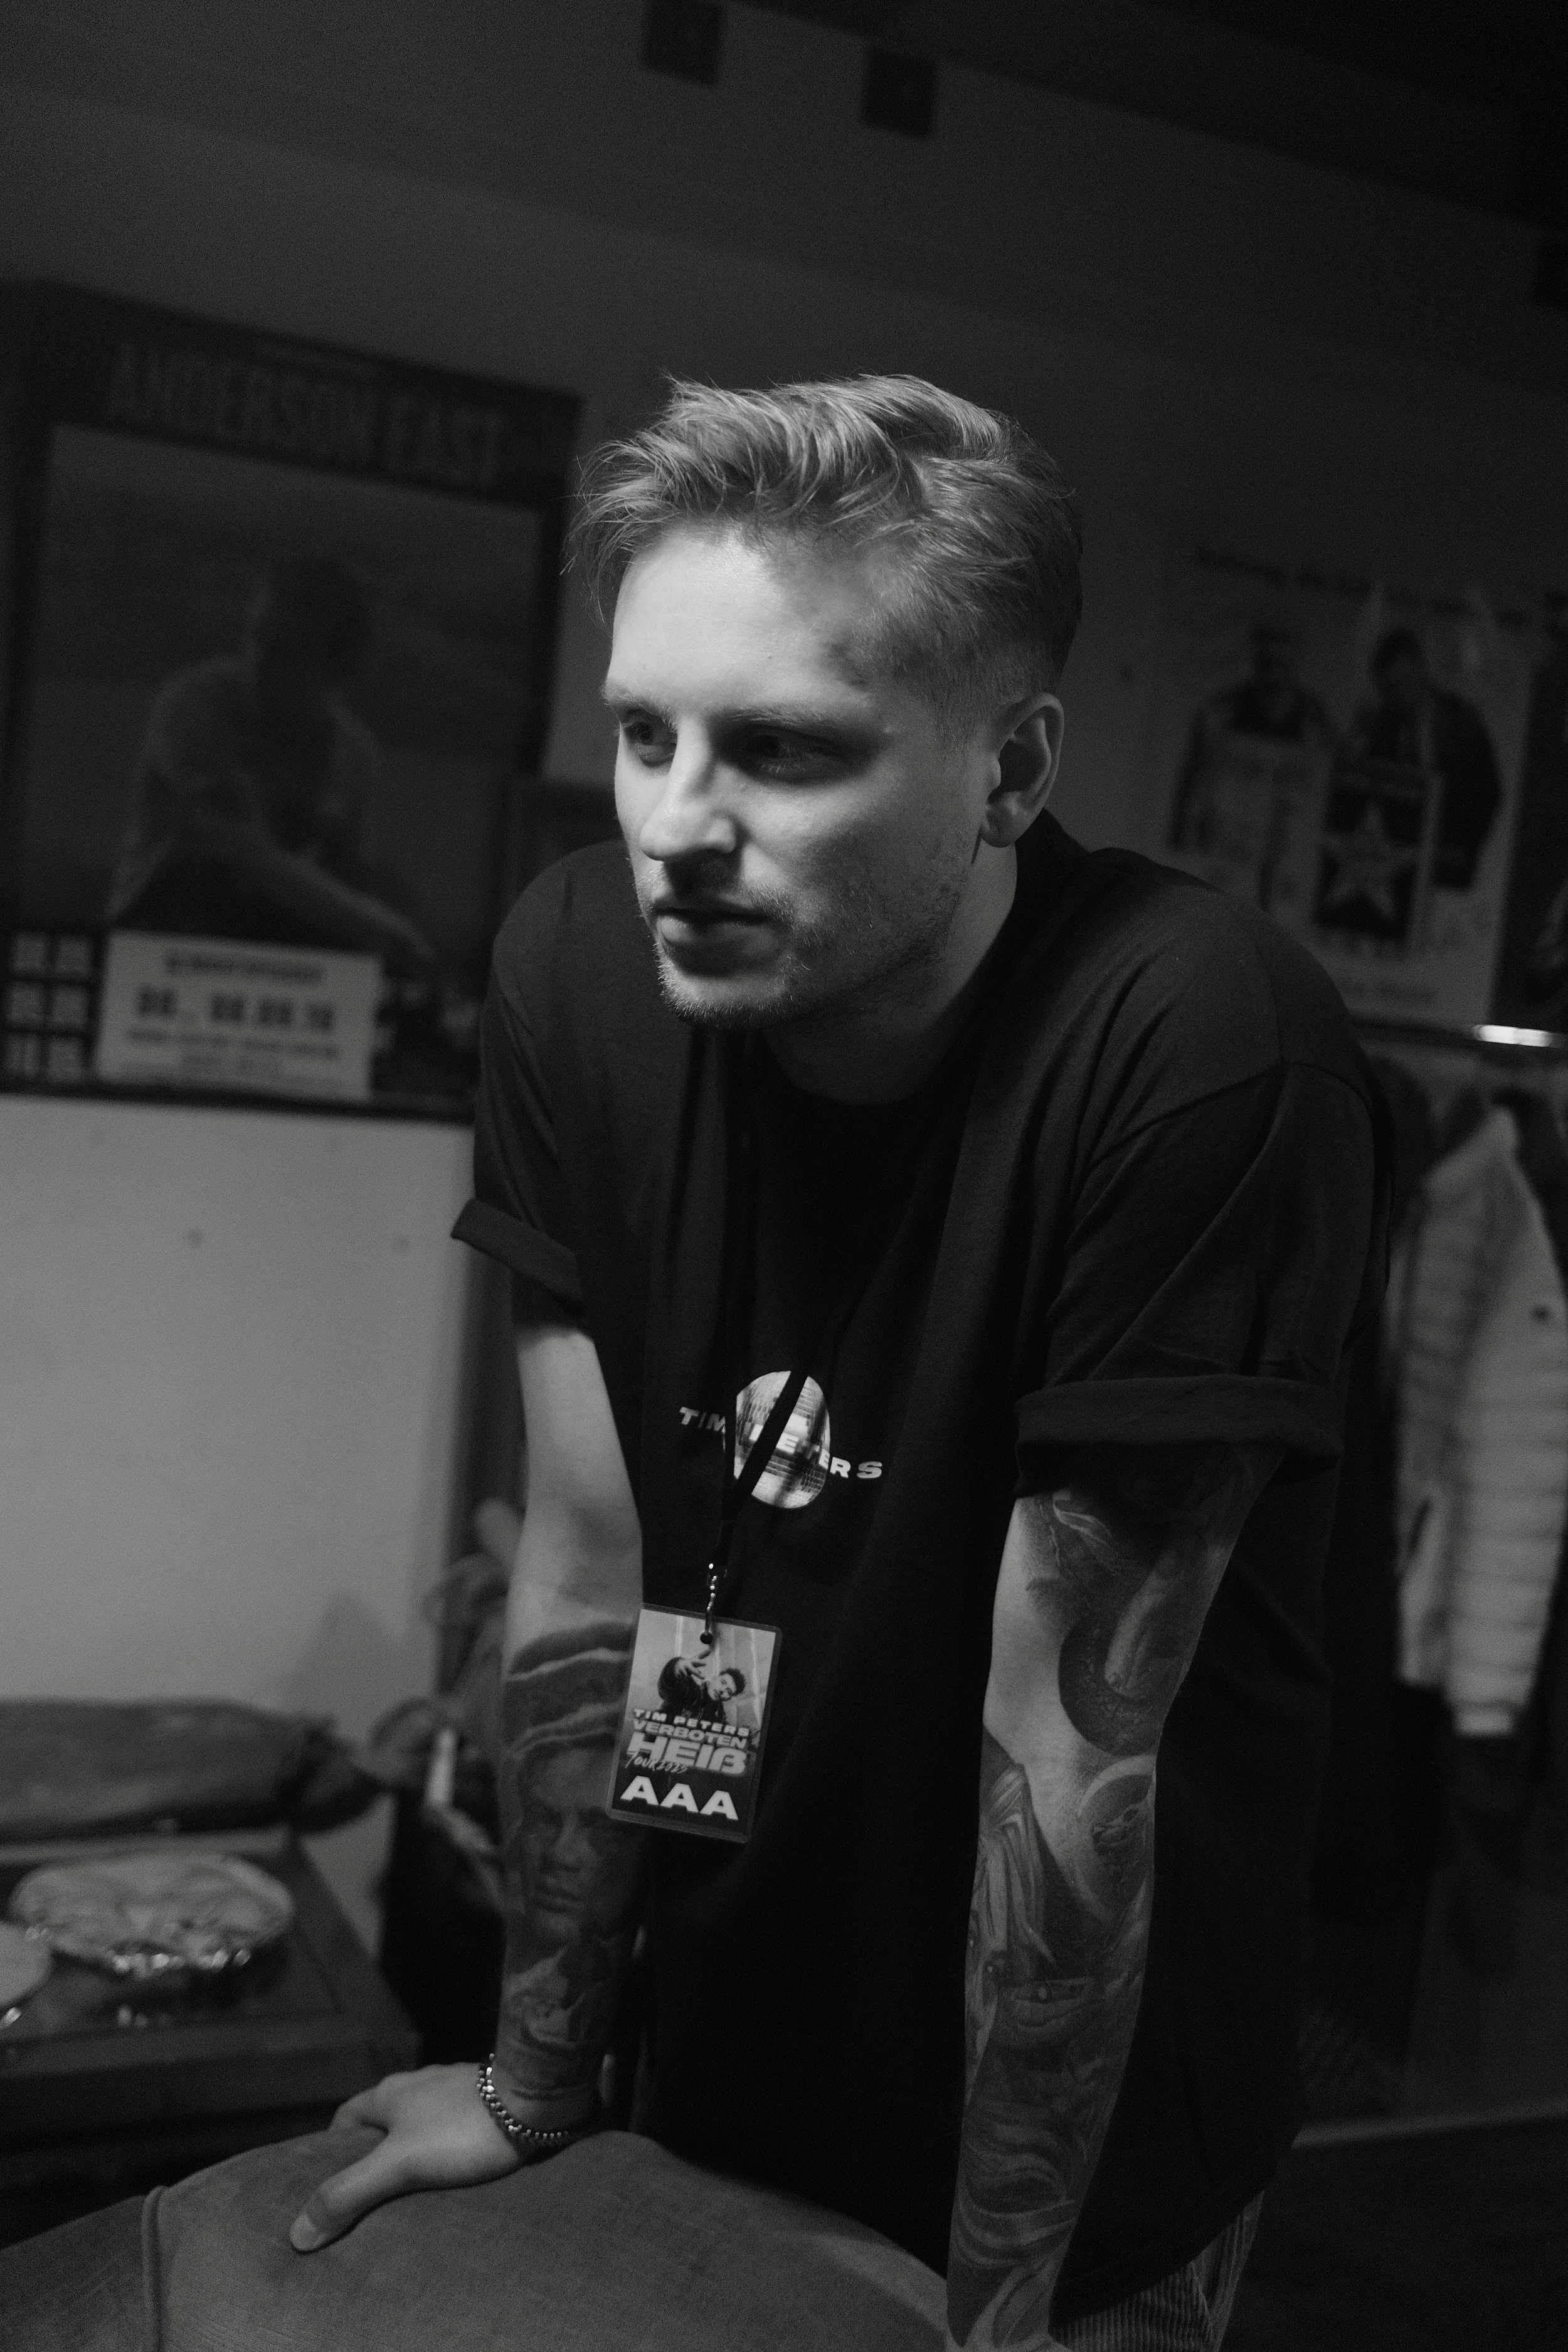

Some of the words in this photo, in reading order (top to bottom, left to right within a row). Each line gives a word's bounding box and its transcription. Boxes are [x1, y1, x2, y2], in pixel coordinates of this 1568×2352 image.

[108, 341, 378, 465] ANDERSON
[385, 395, 506, 488] EAST
[679, 1406, 726, 1433] TIM
[633, 1708, 667, 1722] TIM
[674, 1715, 750, 1737] PETERS
[633, 1719, 748, 1749] VERBOTEN
[620, 1775, 739, 1821] AAA
